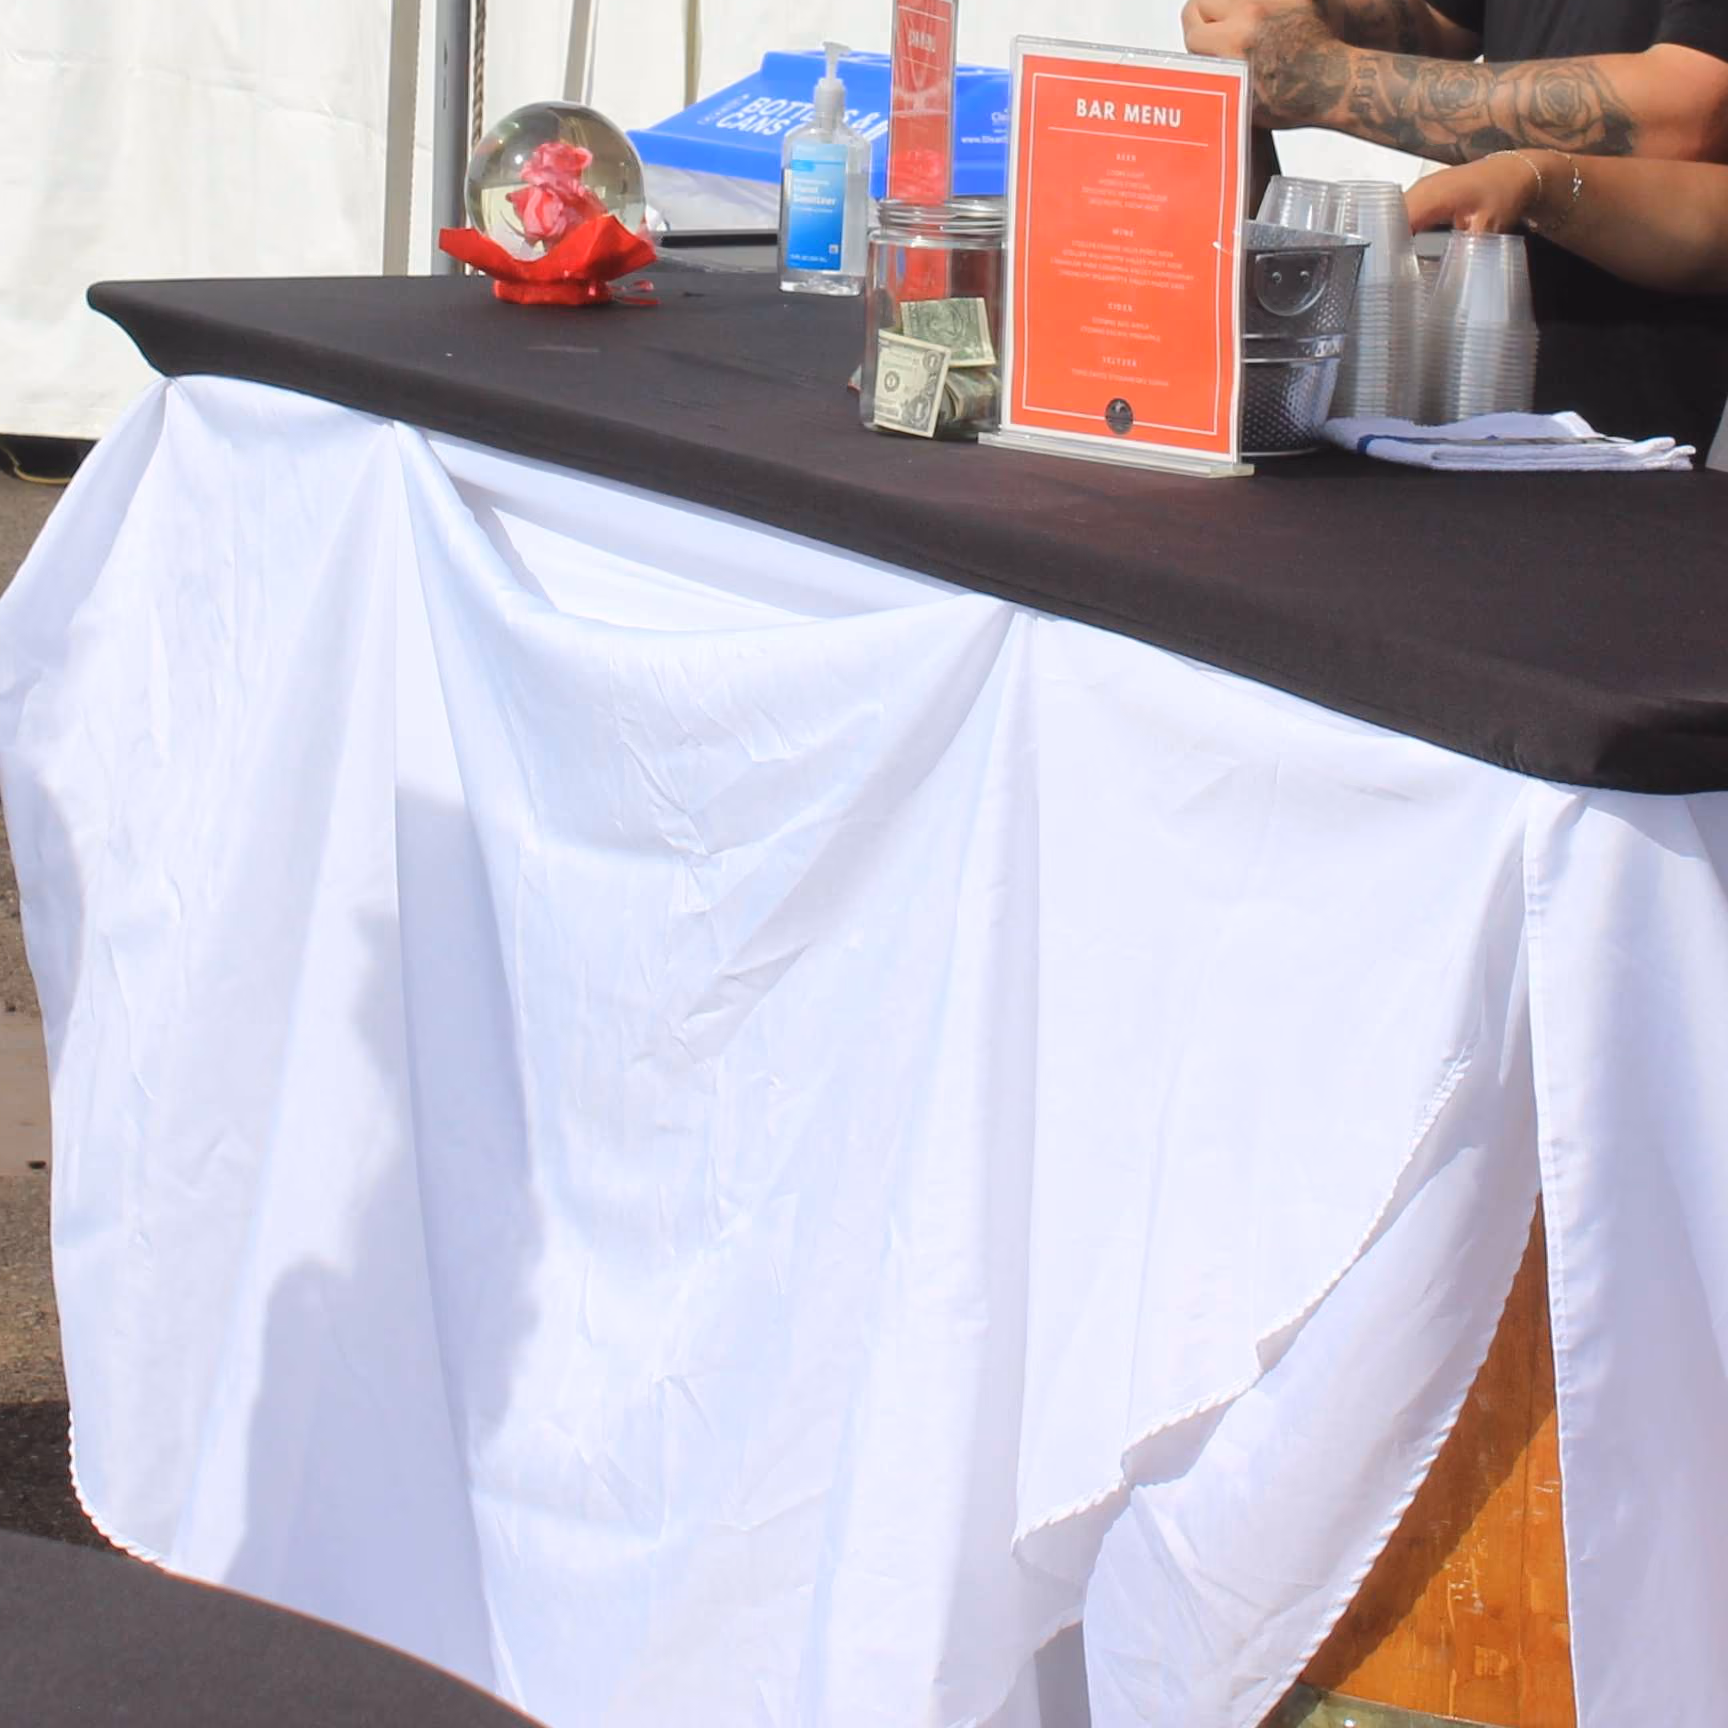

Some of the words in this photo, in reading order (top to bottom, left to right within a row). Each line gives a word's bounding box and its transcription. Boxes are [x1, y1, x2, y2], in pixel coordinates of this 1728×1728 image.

[742, 96, 860, 123] BOTTLS
[1076, 97, 1116, 121] BAR
[1123, 103, 1181, 128] MENU
[716, 111, 792, 137] CANS
